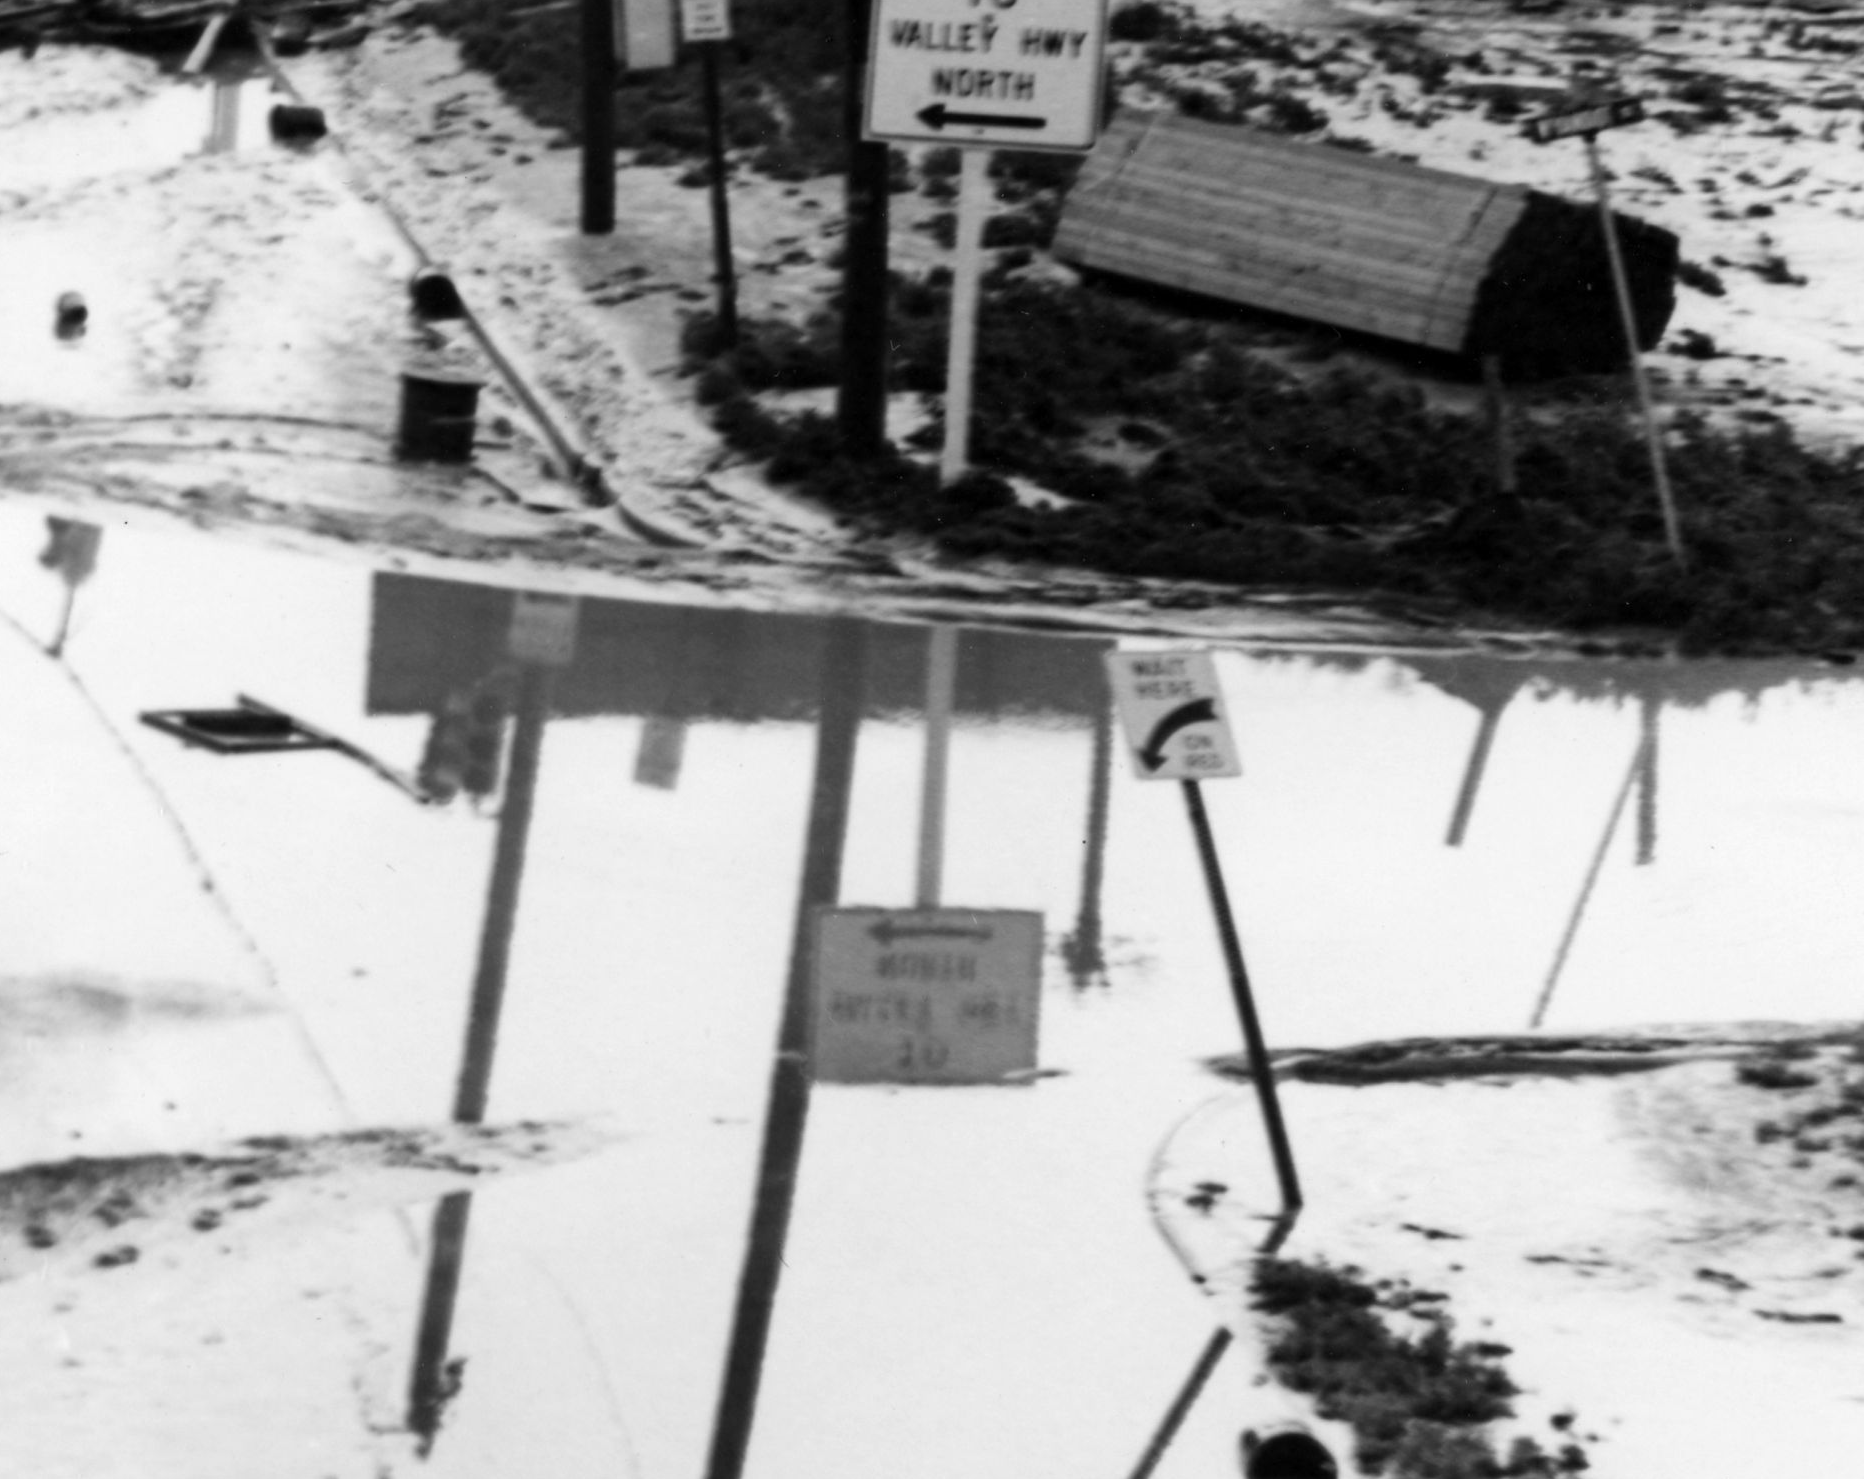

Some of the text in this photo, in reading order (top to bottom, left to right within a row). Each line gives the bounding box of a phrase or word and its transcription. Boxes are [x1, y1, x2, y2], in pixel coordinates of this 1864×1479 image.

[891, 20, 1087, 57] VALLEY HWY
[932, 69, 1035, 99] NORTH
